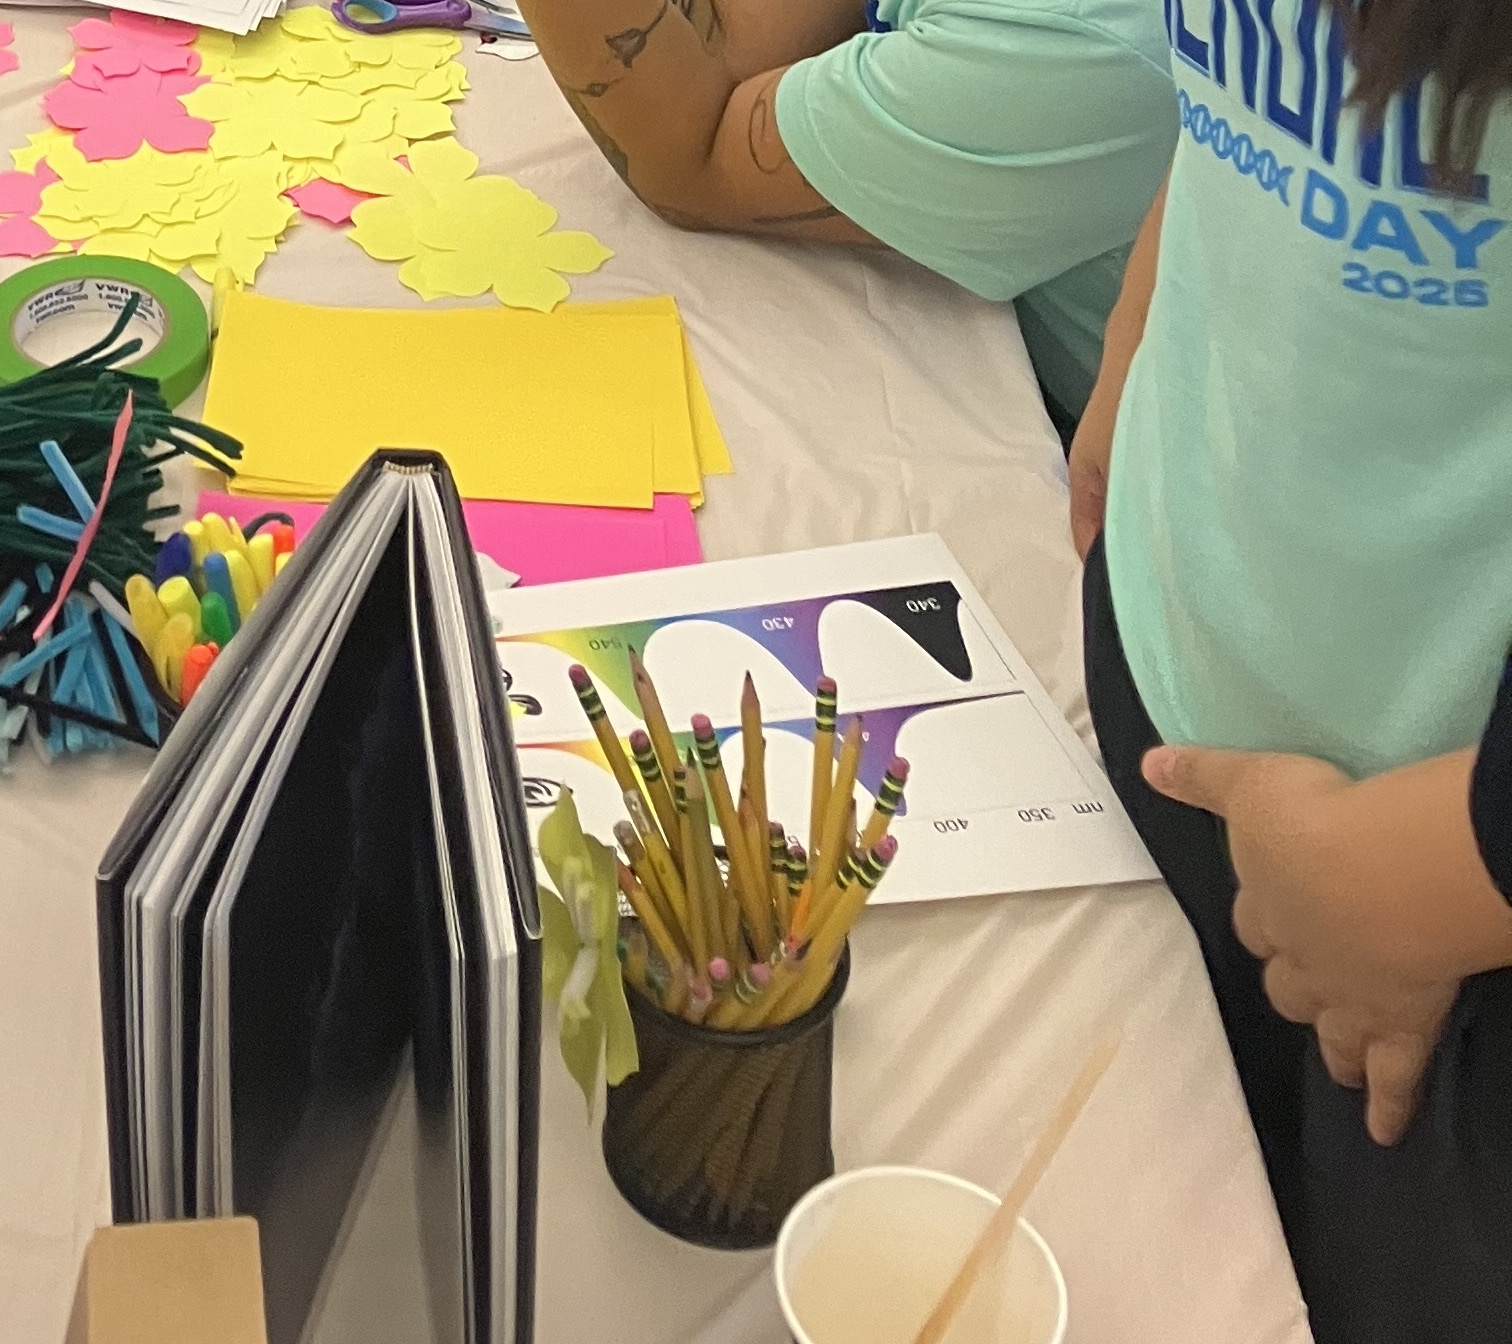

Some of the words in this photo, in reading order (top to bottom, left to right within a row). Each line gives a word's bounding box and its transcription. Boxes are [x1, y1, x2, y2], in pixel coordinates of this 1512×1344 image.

[1299, 168, 1506, 269] DAY
[906, 597, 941, 613] 340
[762, 616, 794, 631] 430
[1017, 807, 1056, 823] 350
[1071, 801, 1104, 814] nm
[933, 817, 969, 834] 400
